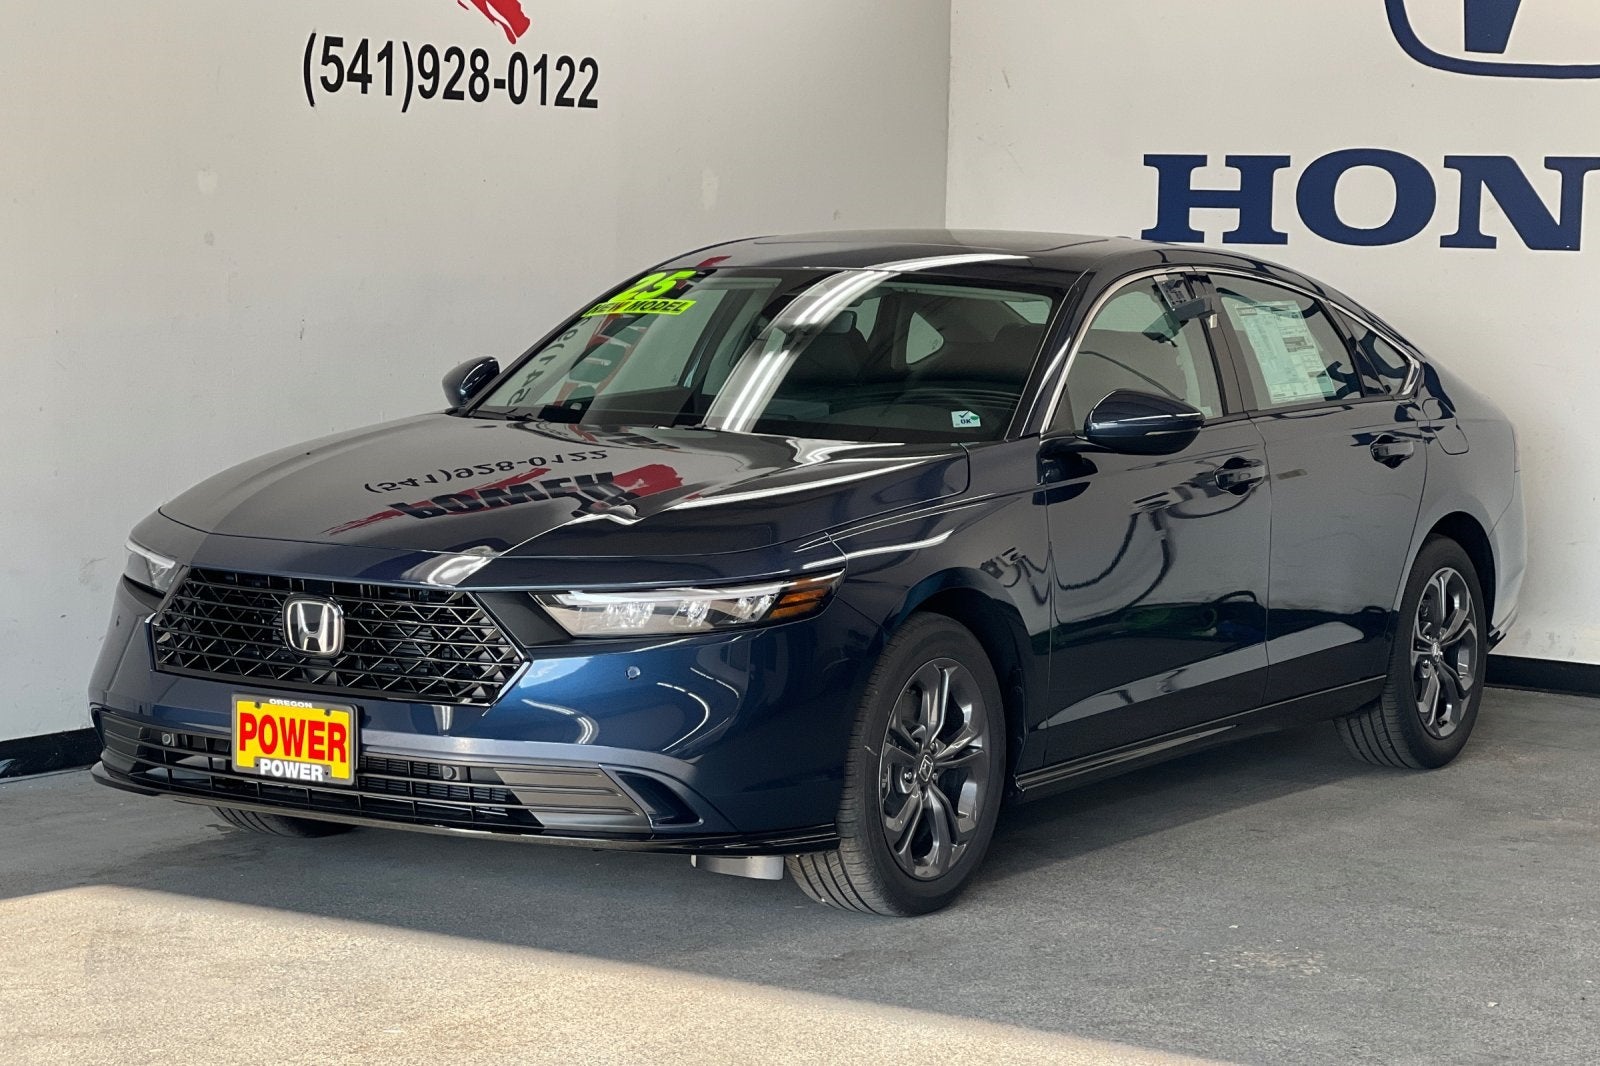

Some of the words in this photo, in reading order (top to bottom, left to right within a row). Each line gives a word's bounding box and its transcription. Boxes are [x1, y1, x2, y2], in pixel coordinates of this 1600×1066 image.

[303, 30, 599, 113] (541)928-0122
[628, 301, 687, 312] MODEL
[268, 698, 313, 709] OREGON
[239, 712, 347, 763] POWER
[259, 758, 324, 782] POWER
